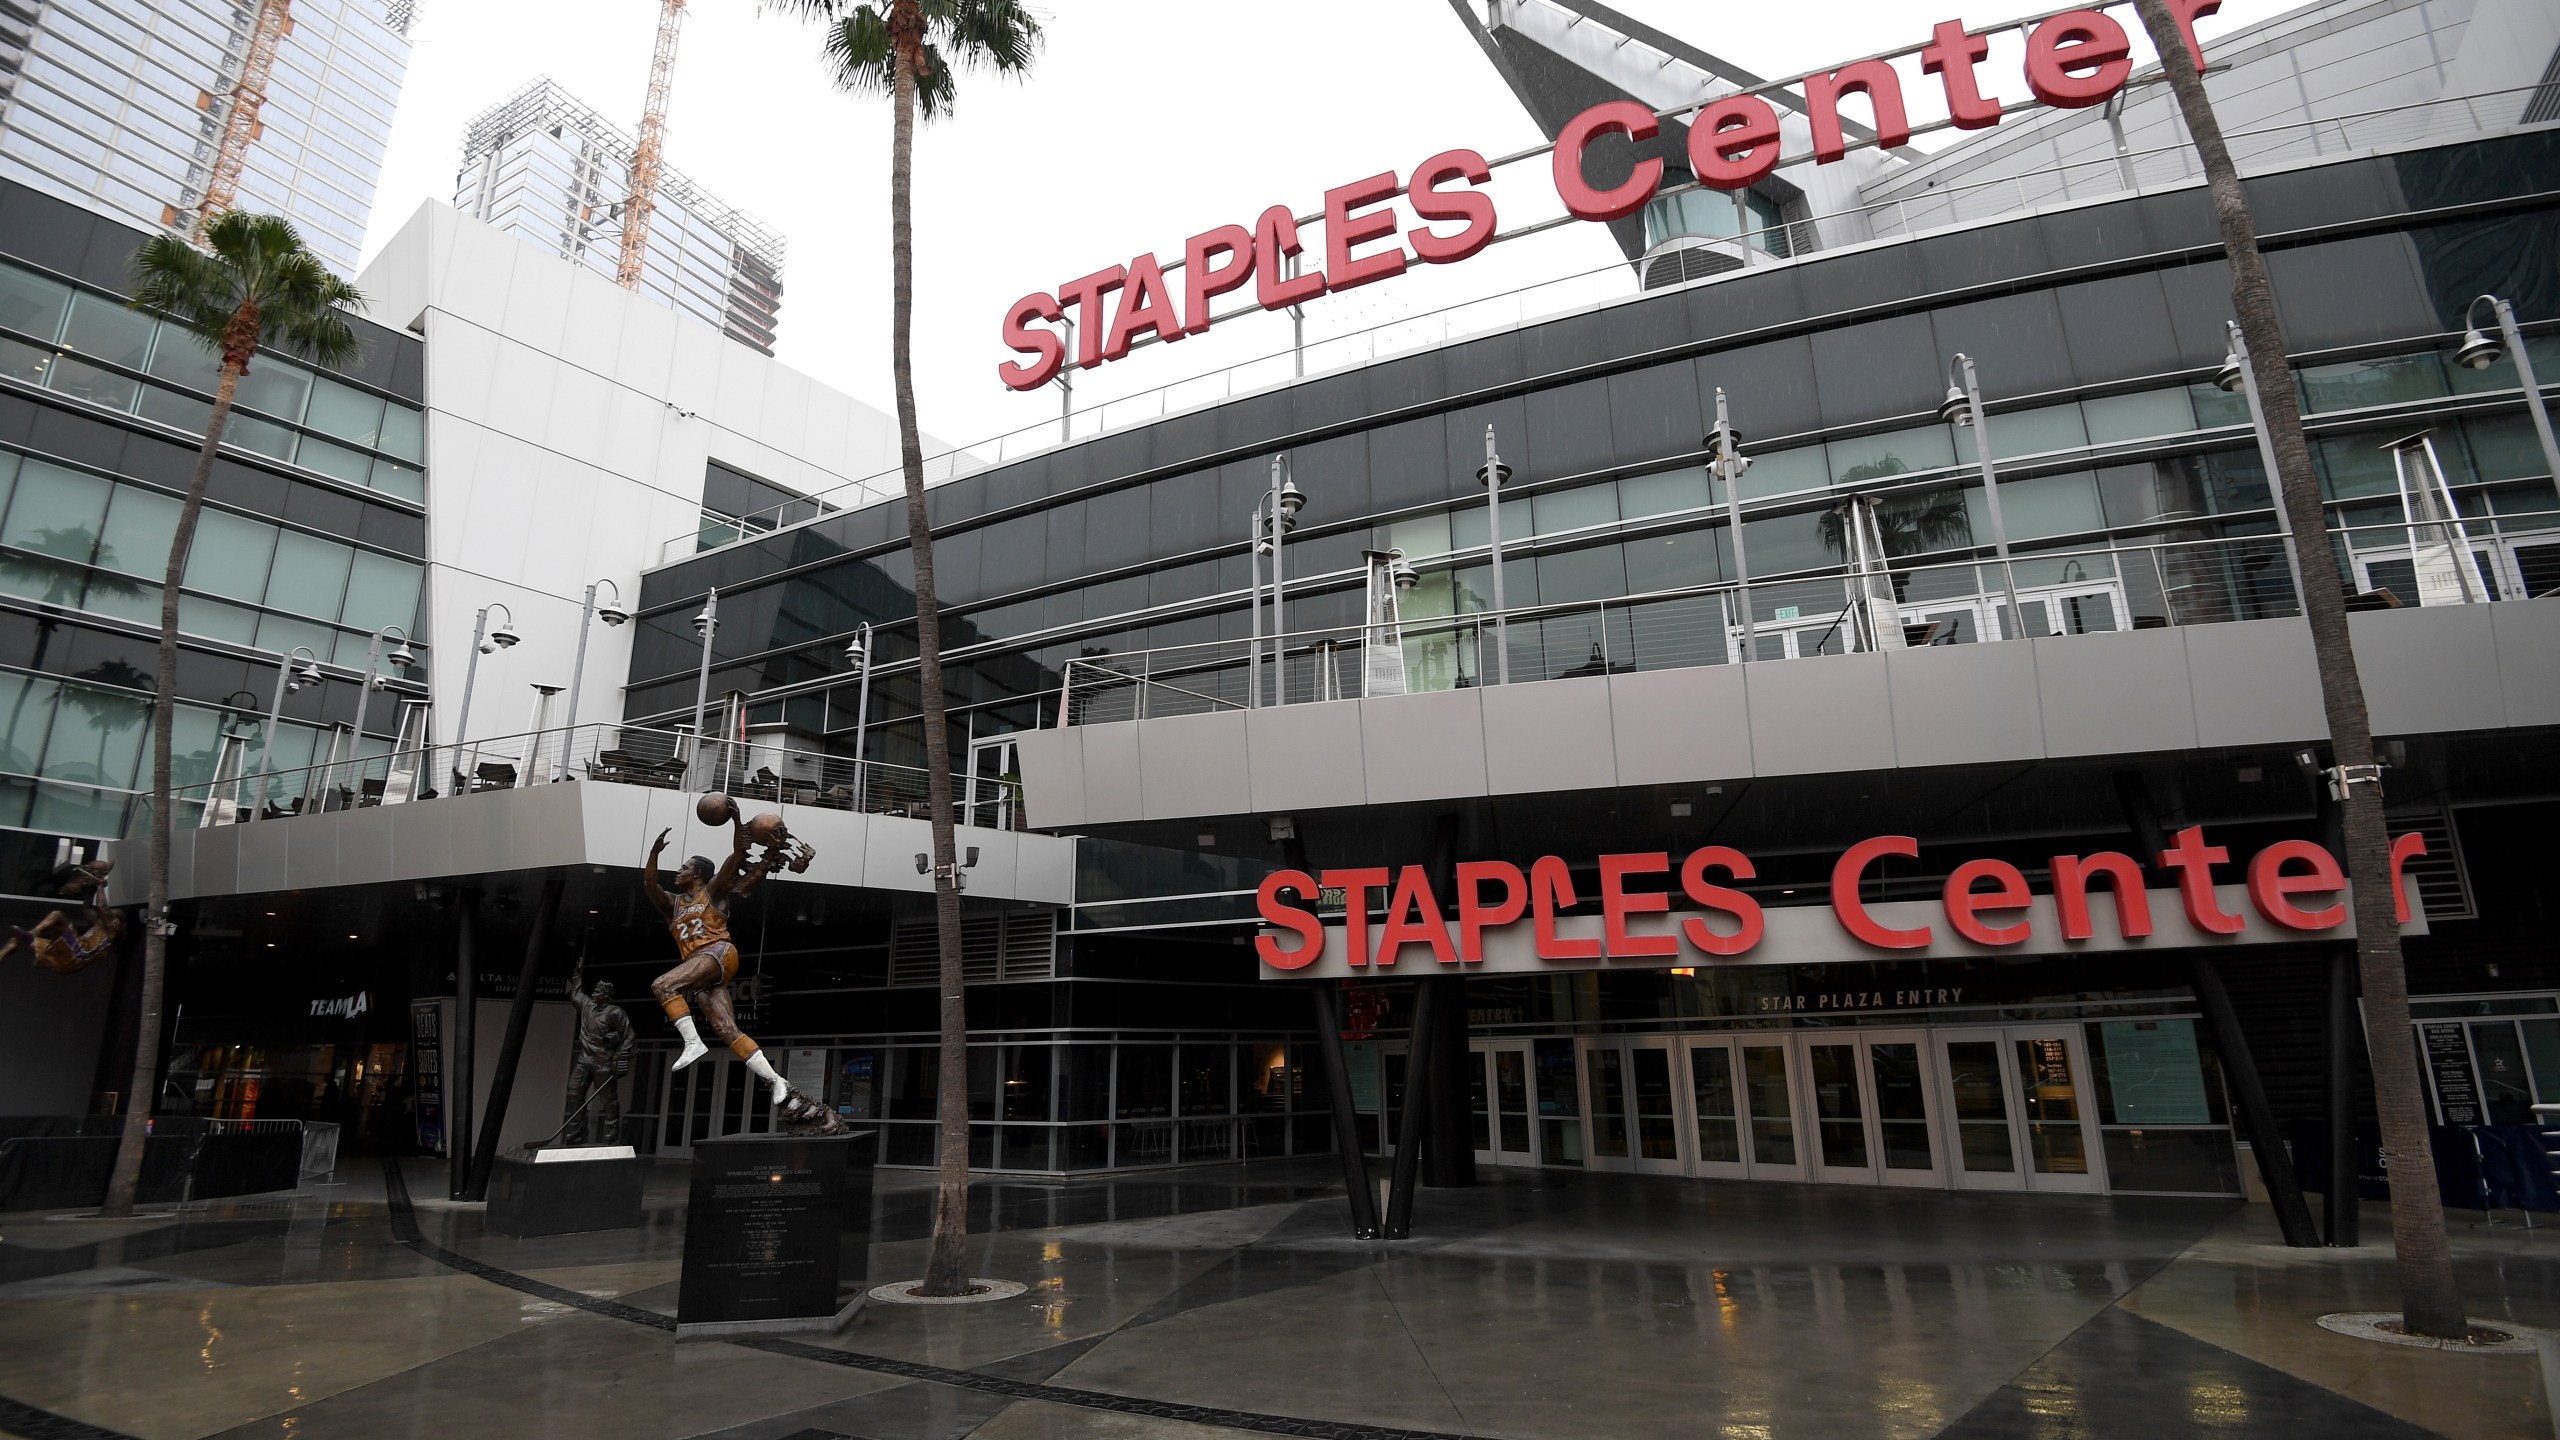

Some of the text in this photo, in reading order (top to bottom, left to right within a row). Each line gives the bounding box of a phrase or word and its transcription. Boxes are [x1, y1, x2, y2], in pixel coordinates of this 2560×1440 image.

[999, 149, 1498, 392] STAPLES
[1254, 846, 1765, 971] STAPLES
[676, 918, 705, 941] 22
[1761, 987, 1963, 1011] STAR PLAZA ENTRY
[2480, 1002, 2492, 1014] 2
[416, 1013, 437, 1038] SEATS
[738, 1013, 760, 1022] RILL
[417, 1049, 438, 1074] SUITES
